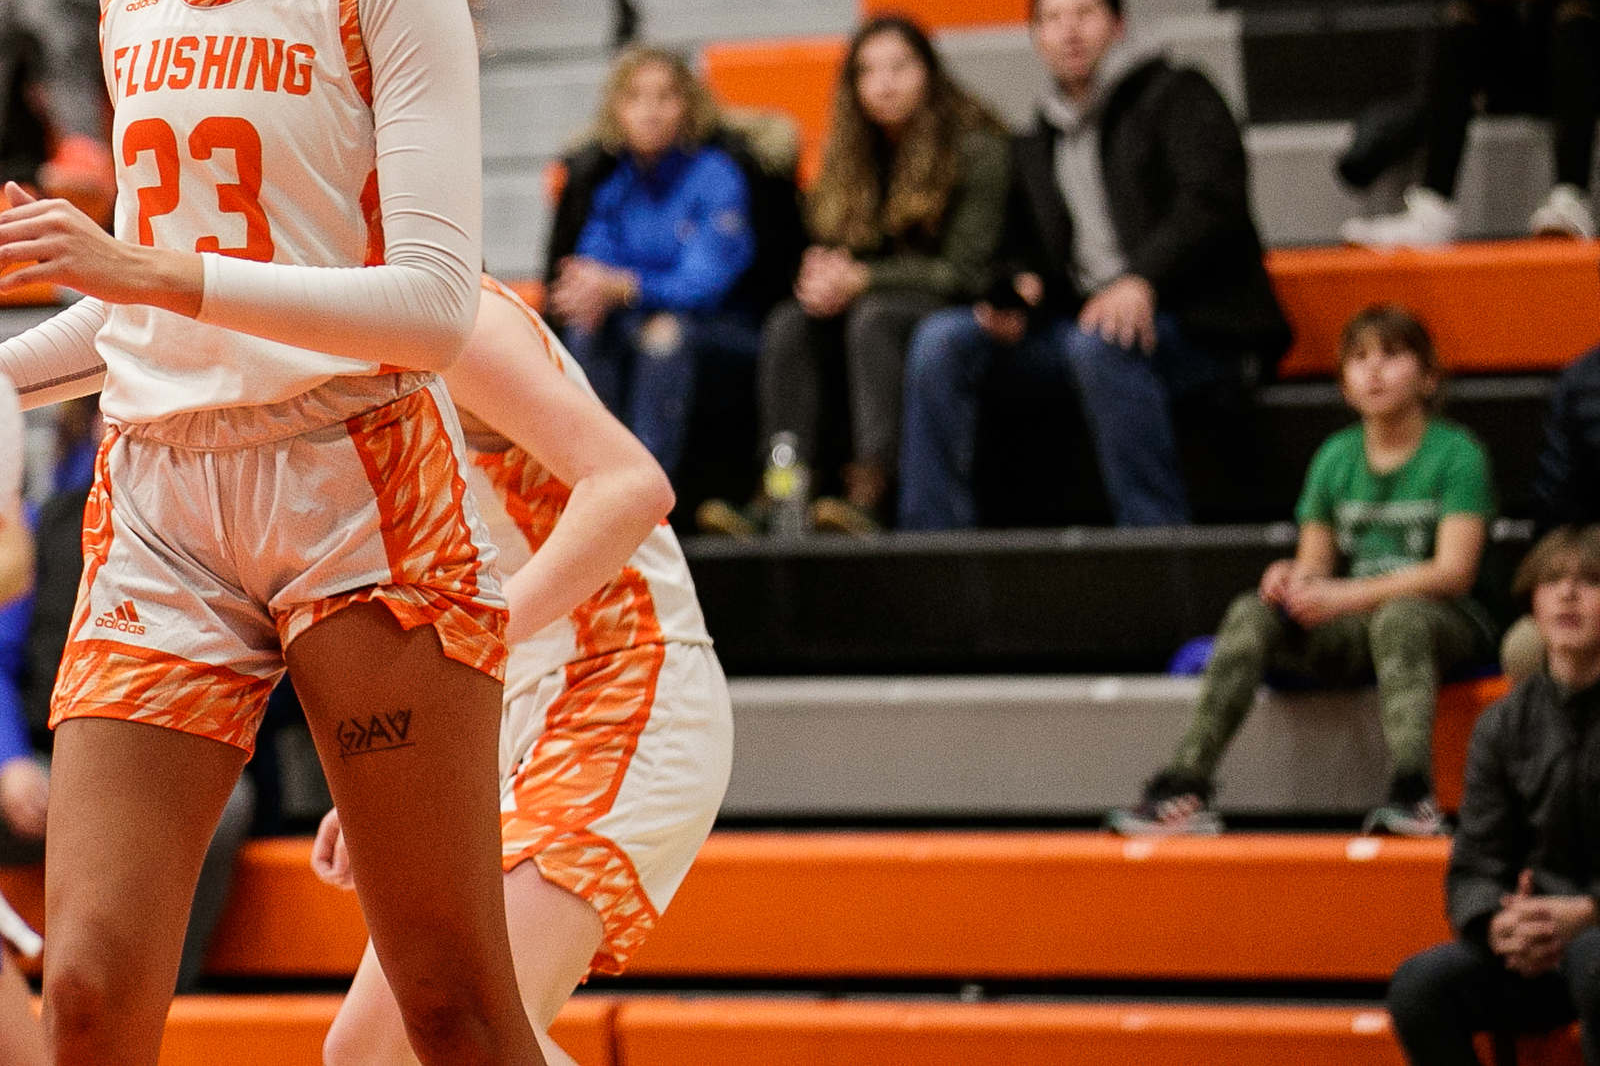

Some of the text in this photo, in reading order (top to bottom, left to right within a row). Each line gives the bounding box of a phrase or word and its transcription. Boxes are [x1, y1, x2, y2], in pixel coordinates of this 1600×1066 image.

[114, 35, 317, 98] FLUSHING
[122, 116, 275, 263] 23
[95, 616, 145, 635] adidas
